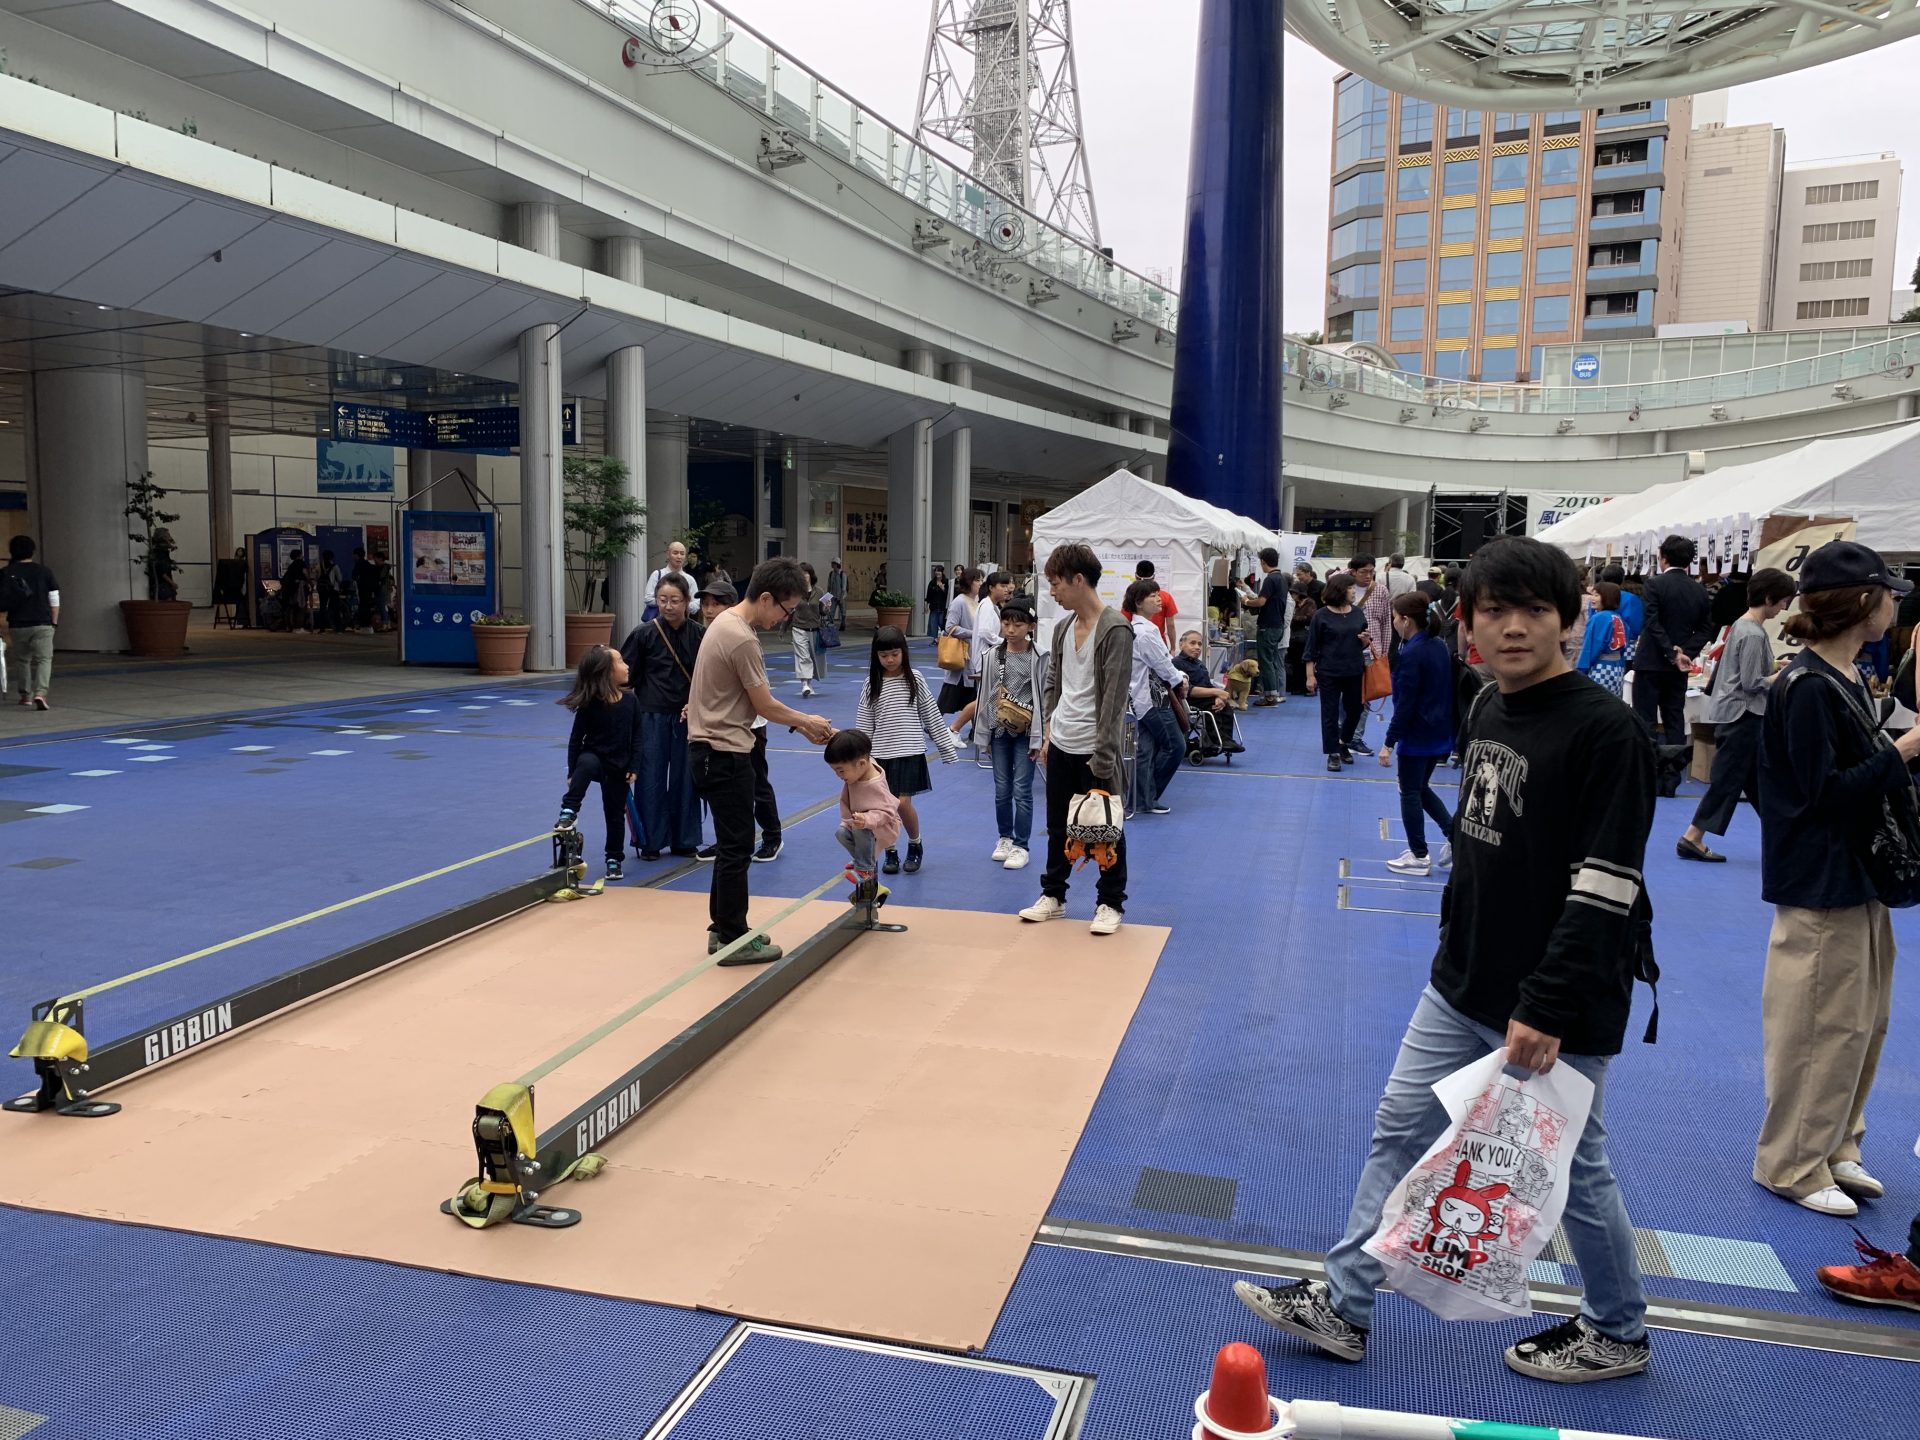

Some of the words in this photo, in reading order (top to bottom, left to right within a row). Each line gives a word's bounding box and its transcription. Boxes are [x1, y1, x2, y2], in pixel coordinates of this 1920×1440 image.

[1553, 496, 1601, 508] 2019
[1538, 510, 1576, 525] 風に
[145, 1002, 232, 1066] GIBBON
[576, 1080, 640, 1158] GIBBON
[1454, 1139, 1486, 1163] HANK
[1488, 1144, 1522, 1169] YOU!
[1409, 1232, 1489, 1271] JUMP
[1422, 1255, 1466, 1280] SHOP
